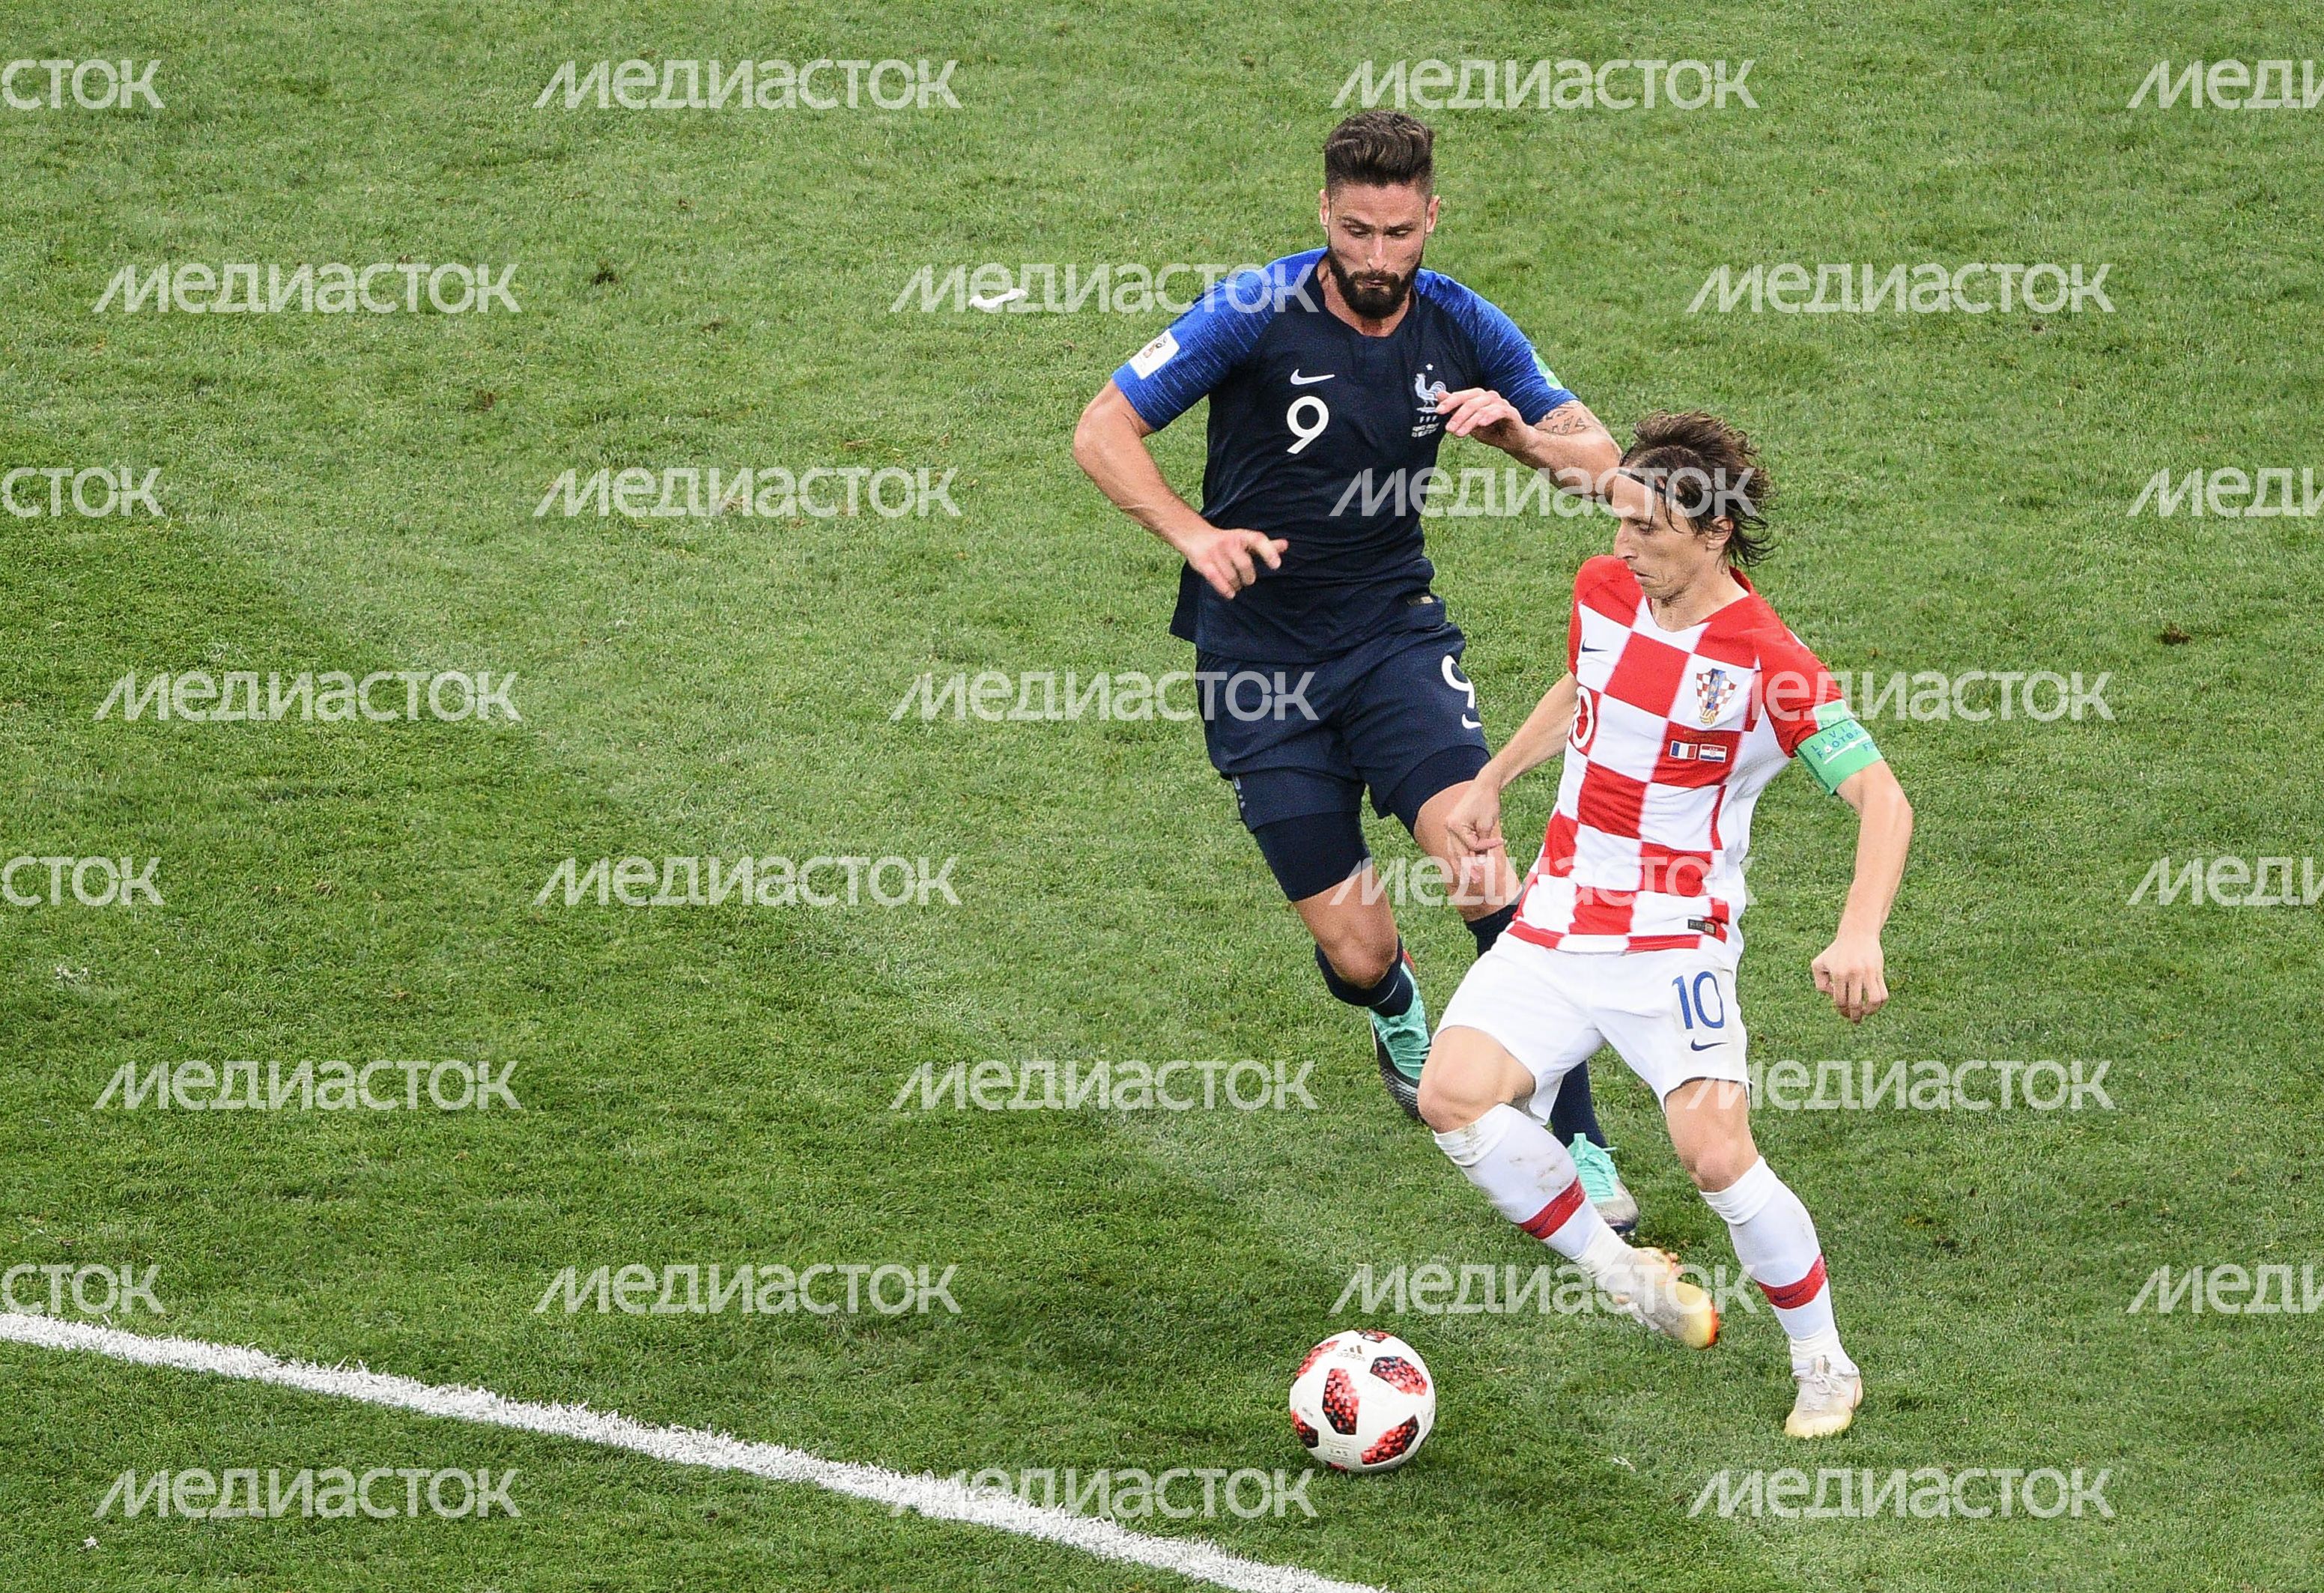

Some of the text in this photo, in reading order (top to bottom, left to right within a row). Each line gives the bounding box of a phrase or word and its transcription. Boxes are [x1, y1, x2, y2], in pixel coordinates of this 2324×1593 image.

[1286, 395, 1329, 455] 9
[1441, 655, 1475, 709] 9
[1572, 686, 1595, 748] 0
[1672, 971, 1725, 1030] 10
